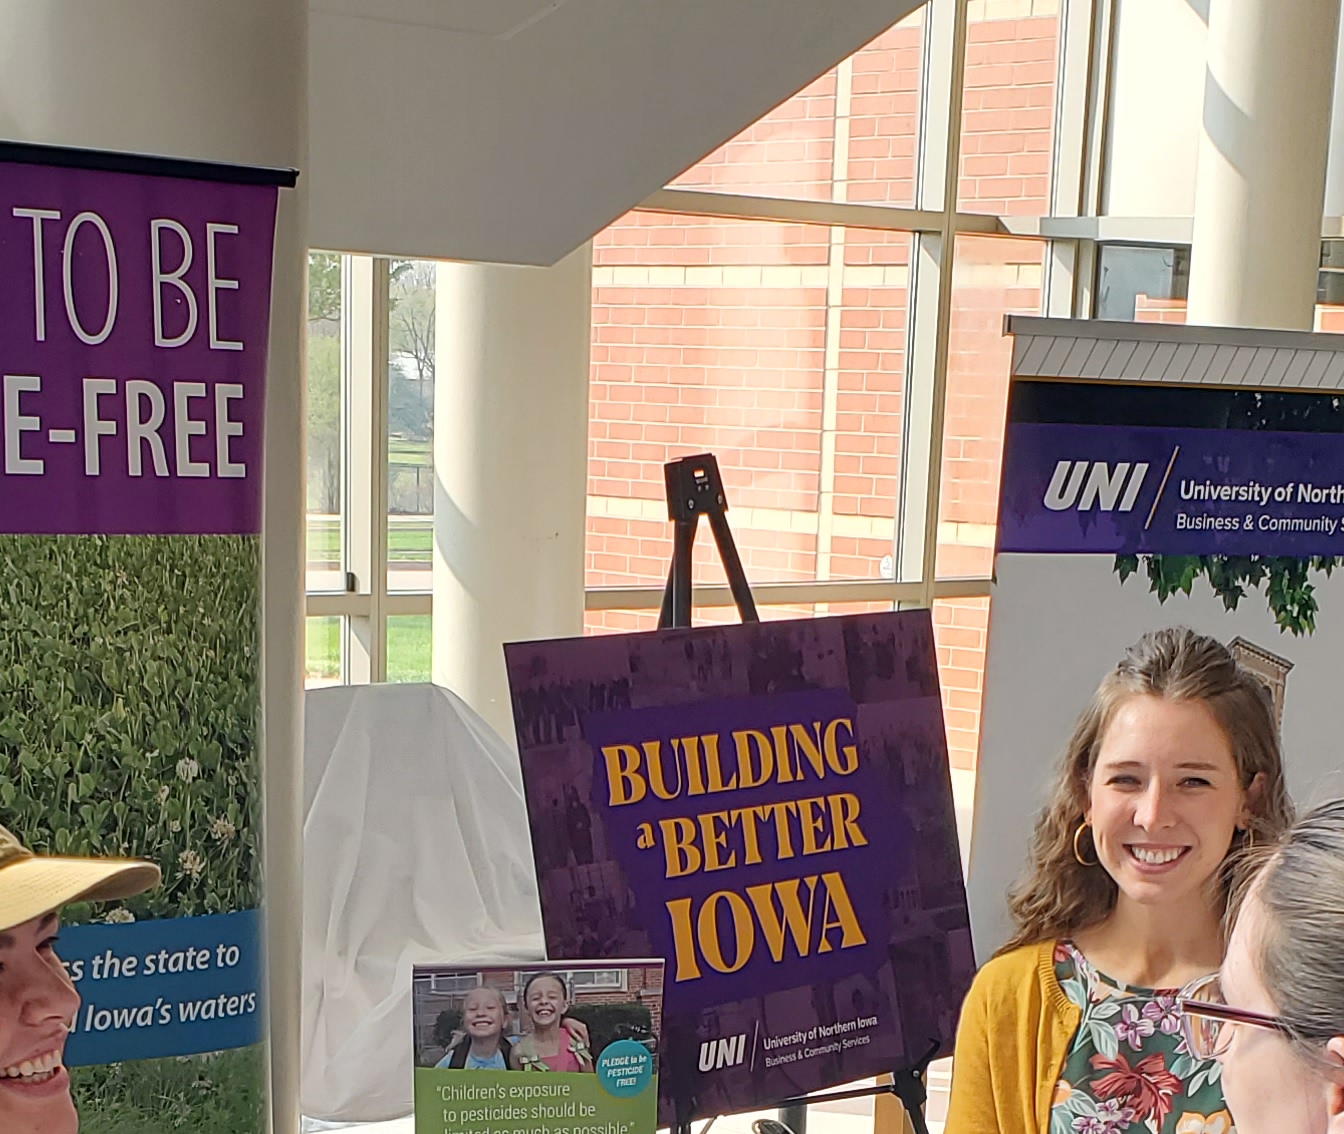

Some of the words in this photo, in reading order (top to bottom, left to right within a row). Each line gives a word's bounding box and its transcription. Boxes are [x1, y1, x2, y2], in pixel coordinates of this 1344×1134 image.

[12, 206, 118, 346] TO
[150, 218, 244, 351] BE
[1042, 459, 1149, 513] UNI
[1180, 479, 1272, 506] University
[1274, 481, 1295, 502] of
[1176, 512, 1240, 531] Business
[1243, 514, 1254, 531] &
[1258, 514, 1338, 535] Community
[600, 717, 860, 808] BUILDING
[636, 821, 655, 851] a
[658, 792, 869, 880] BETTER
[664, 870, 868, 984] IOWA
[92, 946, 137, 981] the
[143, 942, 210, 976] state
[216, 942, 241, 969] to
[85, 996, 172, 1033] Iowa's
[177, 990, 256, 1027] waters
[763, 1031, 808, 1050] University
[808, 1027, 818, 1041] of
[818, 1021, 856, 1038] Northern
[857, 1015, 878, 1029] Iowa
[765, 1053, 797, 1068] Business
[798, 1050, 804, 1060] &
[804, 1042, 842, 1059] Community
[842, 1034, 870, 1049] Services
[607, 1065, 644, 1078] PESTICIDE
[698, 1033, 747, 1073] UNI
[509, 1083, 571, 1101] exposure
[443, 1108, 456, 1123] to
[460, 1106, 528, 1125] pesticides
[530, 1102, 576, 1119] should
[579, 1102, 596, 1117] be
